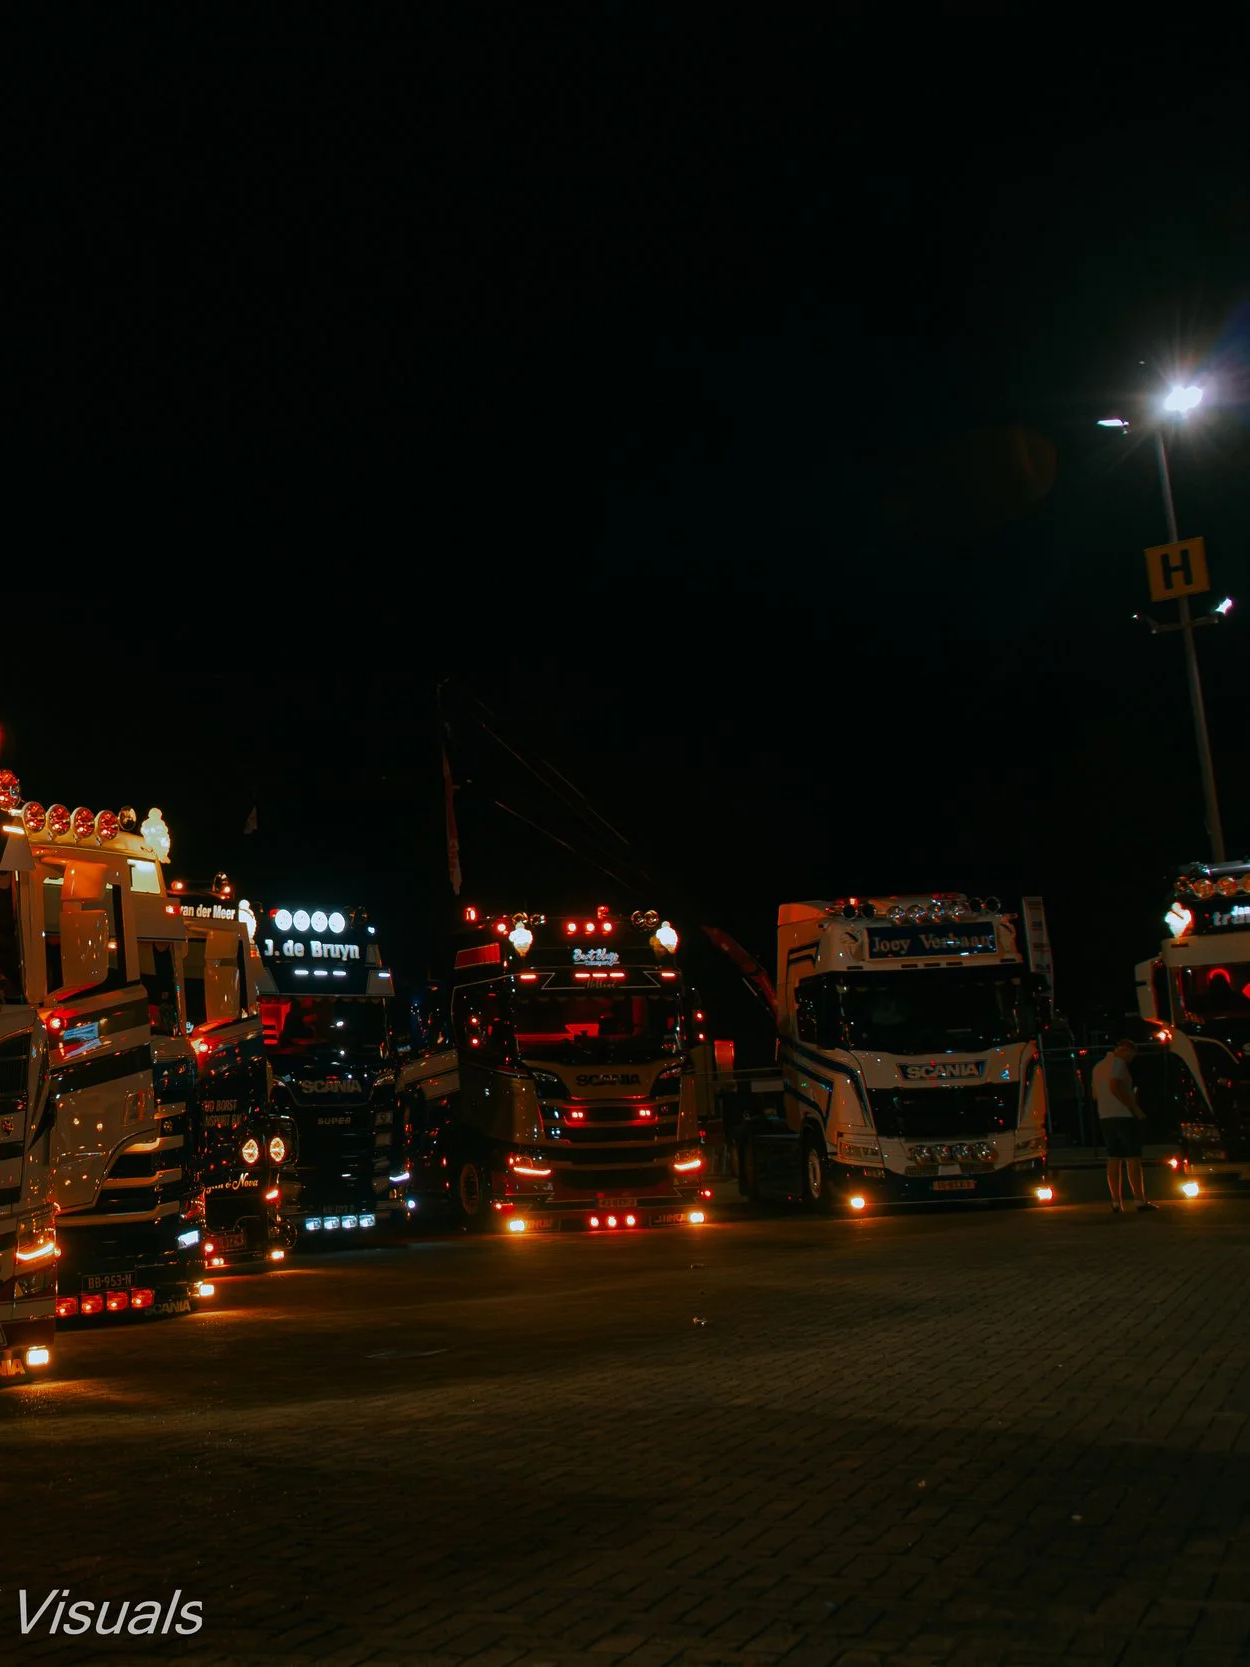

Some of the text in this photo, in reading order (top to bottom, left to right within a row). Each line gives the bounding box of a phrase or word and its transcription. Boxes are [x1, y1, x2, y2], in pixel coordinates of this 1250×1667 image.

[1160, 549, 1193, 590] H
[196, 904, 211, 918] der
[213, 905, 235, 920] Meer
[283, 939, 305, 957] de
[310, 940, 360, 961] Bruyn
[906, 1062, 980, 1079] SCANIA
[301, 1079, 363, 1094] SCANIA
[576, 1073, 642, 1087] SCANIA
